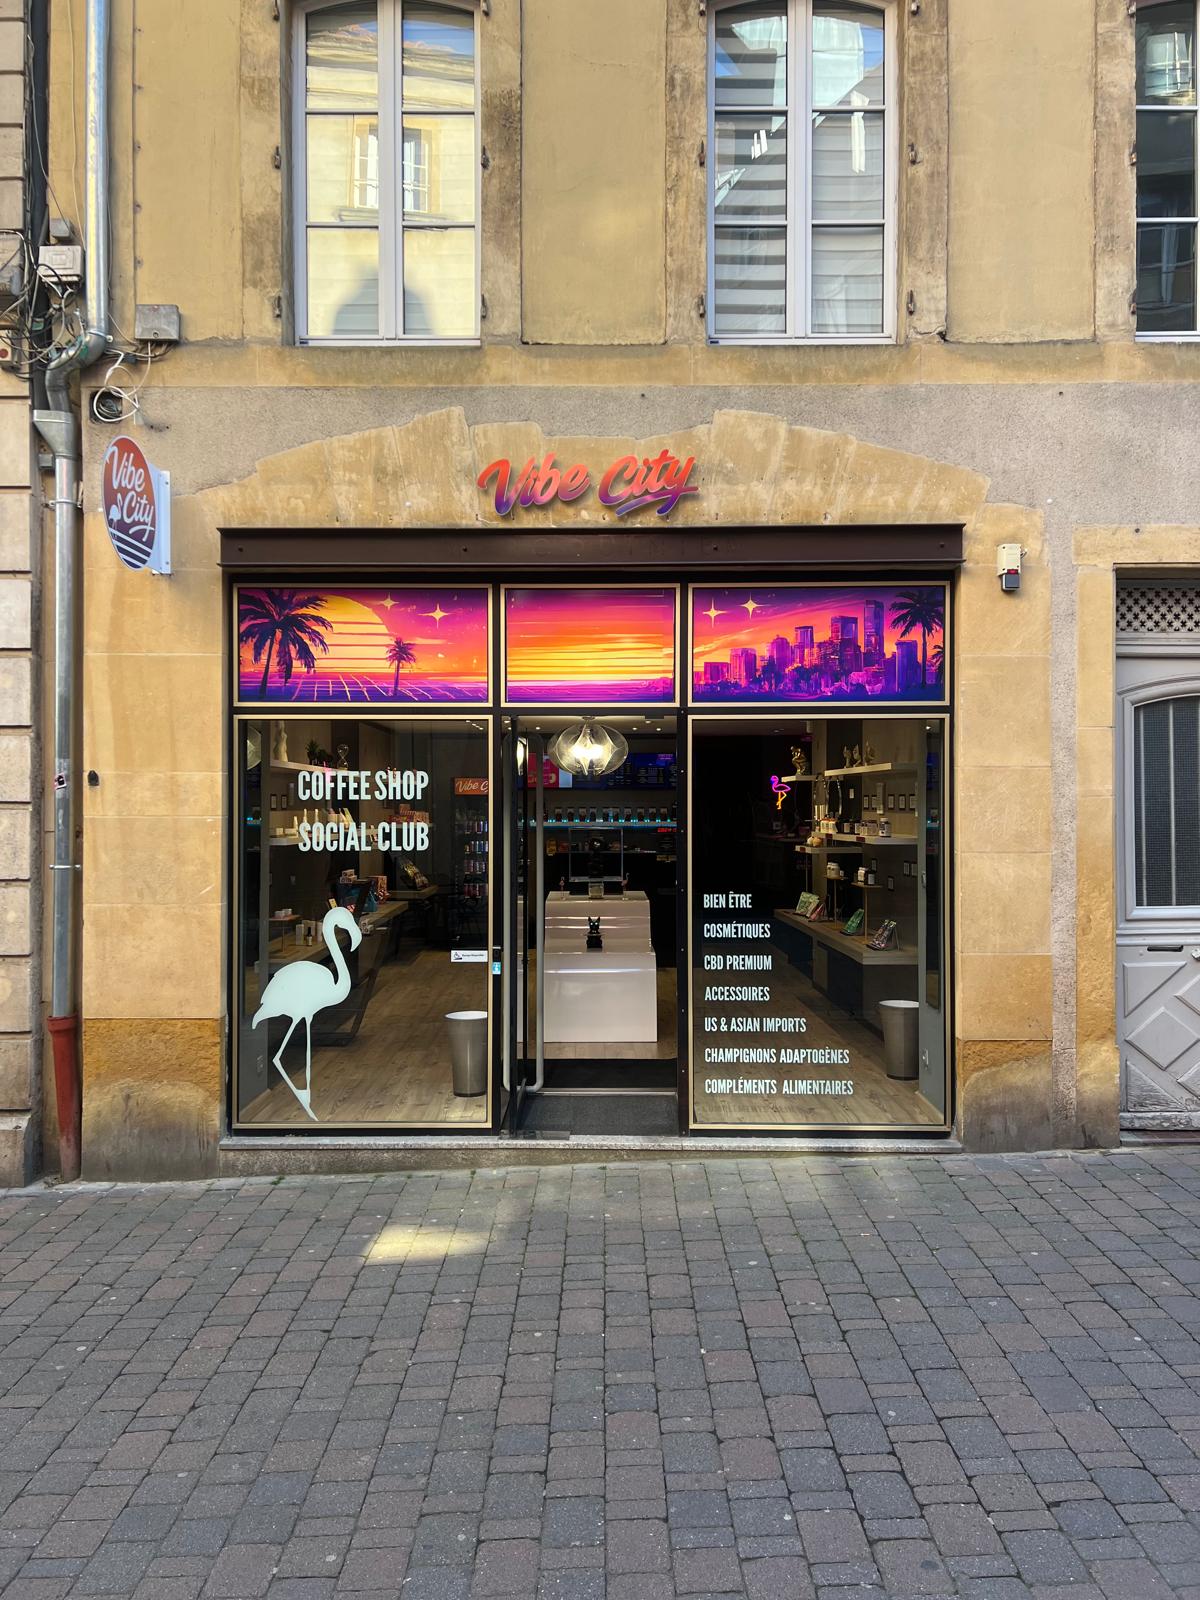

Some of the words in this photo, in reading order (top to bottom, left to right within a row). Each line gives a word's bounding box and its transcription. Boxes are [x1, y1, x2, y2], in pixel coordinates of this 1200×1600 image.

[105, 445, 145, 491] Vibe
[477, 452, 590, 516] Vibe
[598, 449, 699, 516] City
[122, 492, 155, 542] City
[297, 770, 372, 801] COFFEE
[374, 770, 429, 801] SHOP
[455, 779, 479, 793] Vibe
[298, 821, 372, 852] SOCIAL
[377, 821, 430, 852] CLUB
[703, 893, 726, 909] BIEN
[728, 891, 753, 909] ÊTRE
[703, 920, 771, 939] COSMÉTIQUES
[704, 955, 724, 970] CBD
[726, 955, 772, 971] PREMIUM
[704, 986, 770, 1001] ACCESSOIRES
[704, 1017, 718, 1032] US
[720, 1017, 728, 1032] &
[730, 1017, 760, 1032] ASIAN
[762, 1018, 807, 1033] IMPORTS
[704, 1048, 777, 1063] CHAMPIGNONS
[779, 1047, 850, 1064] ADAPTOGÈNES
[705, 1077, 777, 1094] COMPLÉMENTS
[782, 1080, 854, 1095] ALIMENTAIRES
